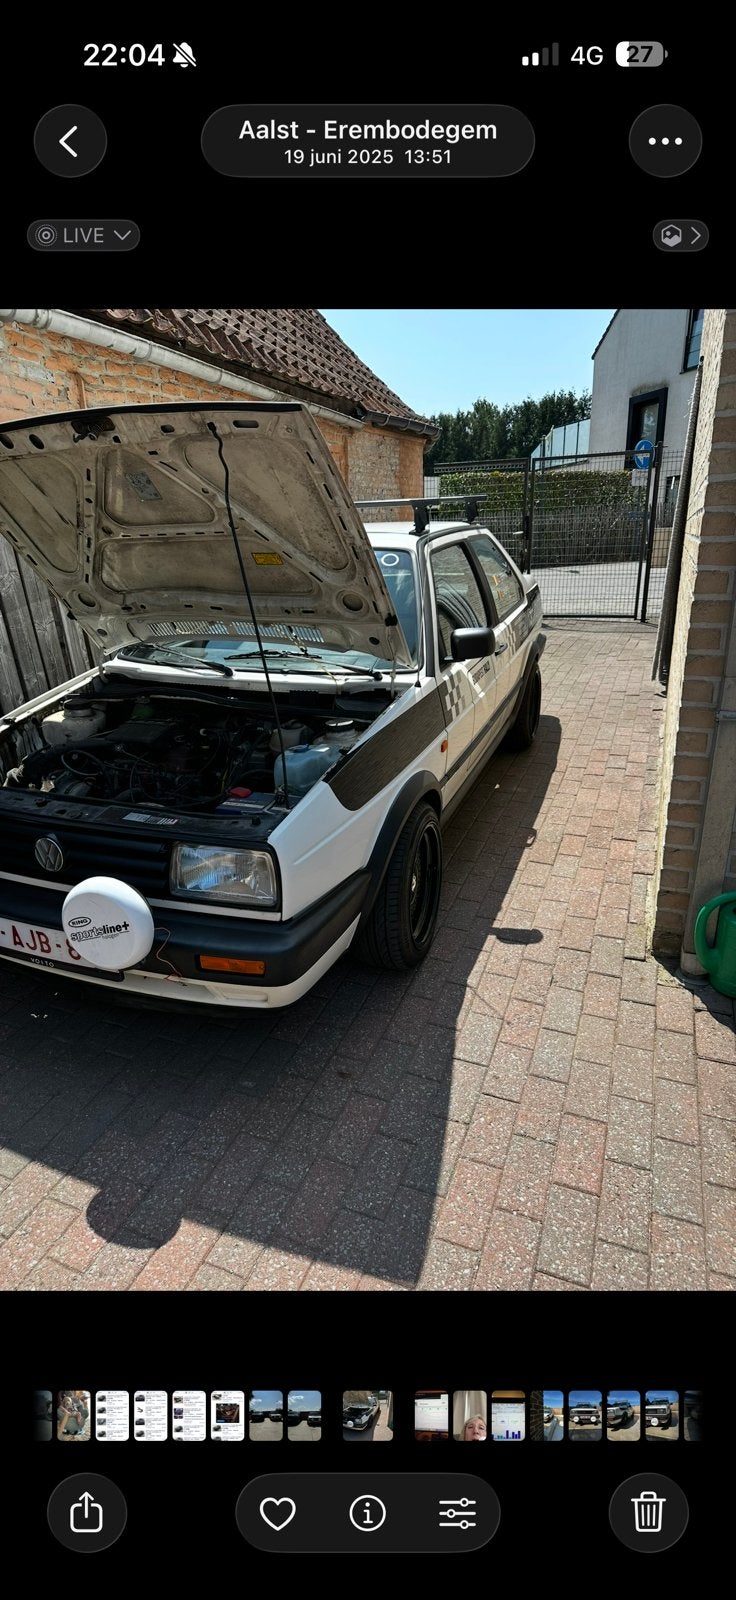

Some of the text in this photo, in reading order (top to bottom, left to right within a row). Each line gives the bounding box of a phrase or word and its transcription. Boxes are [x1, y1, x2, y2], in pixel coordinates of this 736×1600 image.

[83, 43, 165, 67] 22:04
[570, 45, 604, 66] 4G
[626, 45, 654, 63] 27
[238, 119, 298, 140] Aalst
[324, 119, 497, 144] Erembodegem
[284, 148, 451, 168] 19 juni 2025 13:51
[63, 227, 104, 243] LIVE
